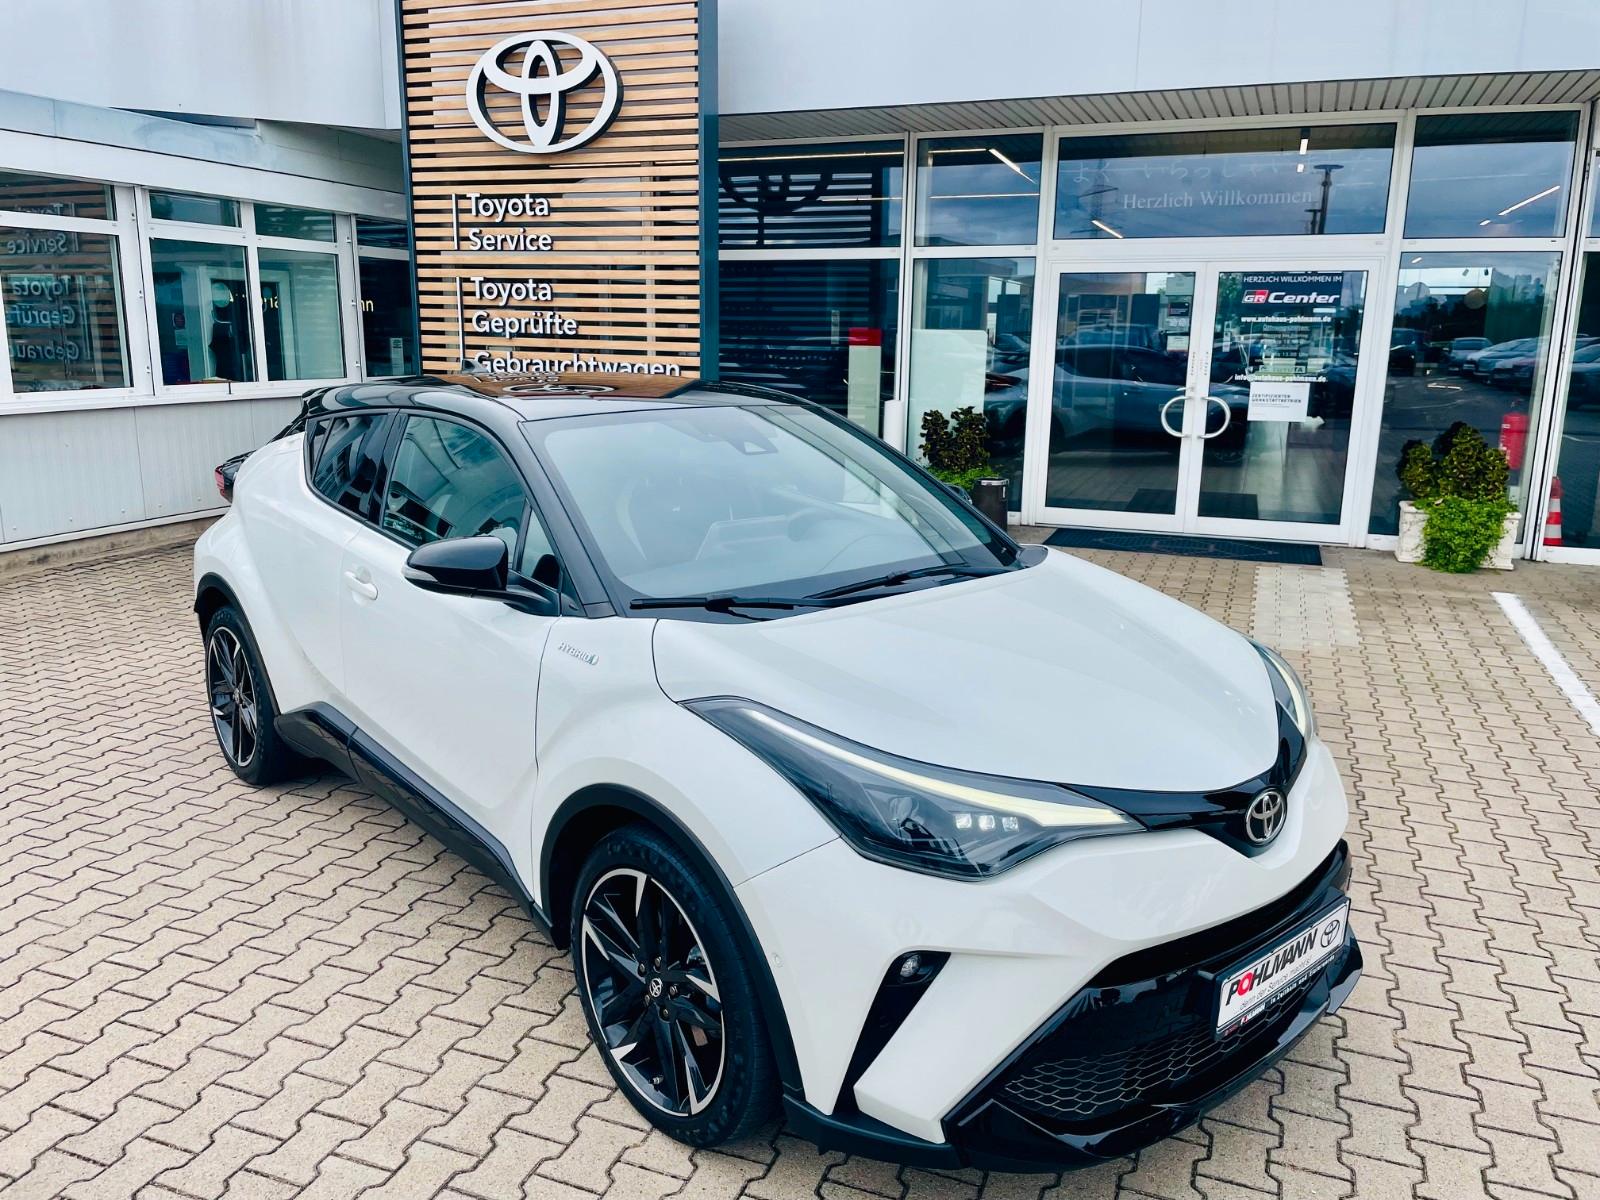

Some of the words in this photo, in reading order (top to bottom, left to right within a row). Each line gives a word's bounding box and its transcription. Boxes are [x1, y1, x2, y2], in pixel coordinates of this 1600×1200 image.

[466, 193, 550, 222] Toyota
[1123, 192, 1193, 209] Herzlich
[1200, 190, 1312, 206] Willkommen
[468, 228, 553, 251] Service
[470, 276, 553, 306] Toyota
[1243, 275, 1280, 283] HERZLICH
[1280, 275, 1331, 283] WILLKOMMEN
[1332, 275, 1343, 283] IM
[1243, 292, 1268, 303] GR
[1268, 292, 1340, 303] Center
[471, 310, 578, 338] Geprüfte
[1225, 928, 1318, 1006] POHLMANN
